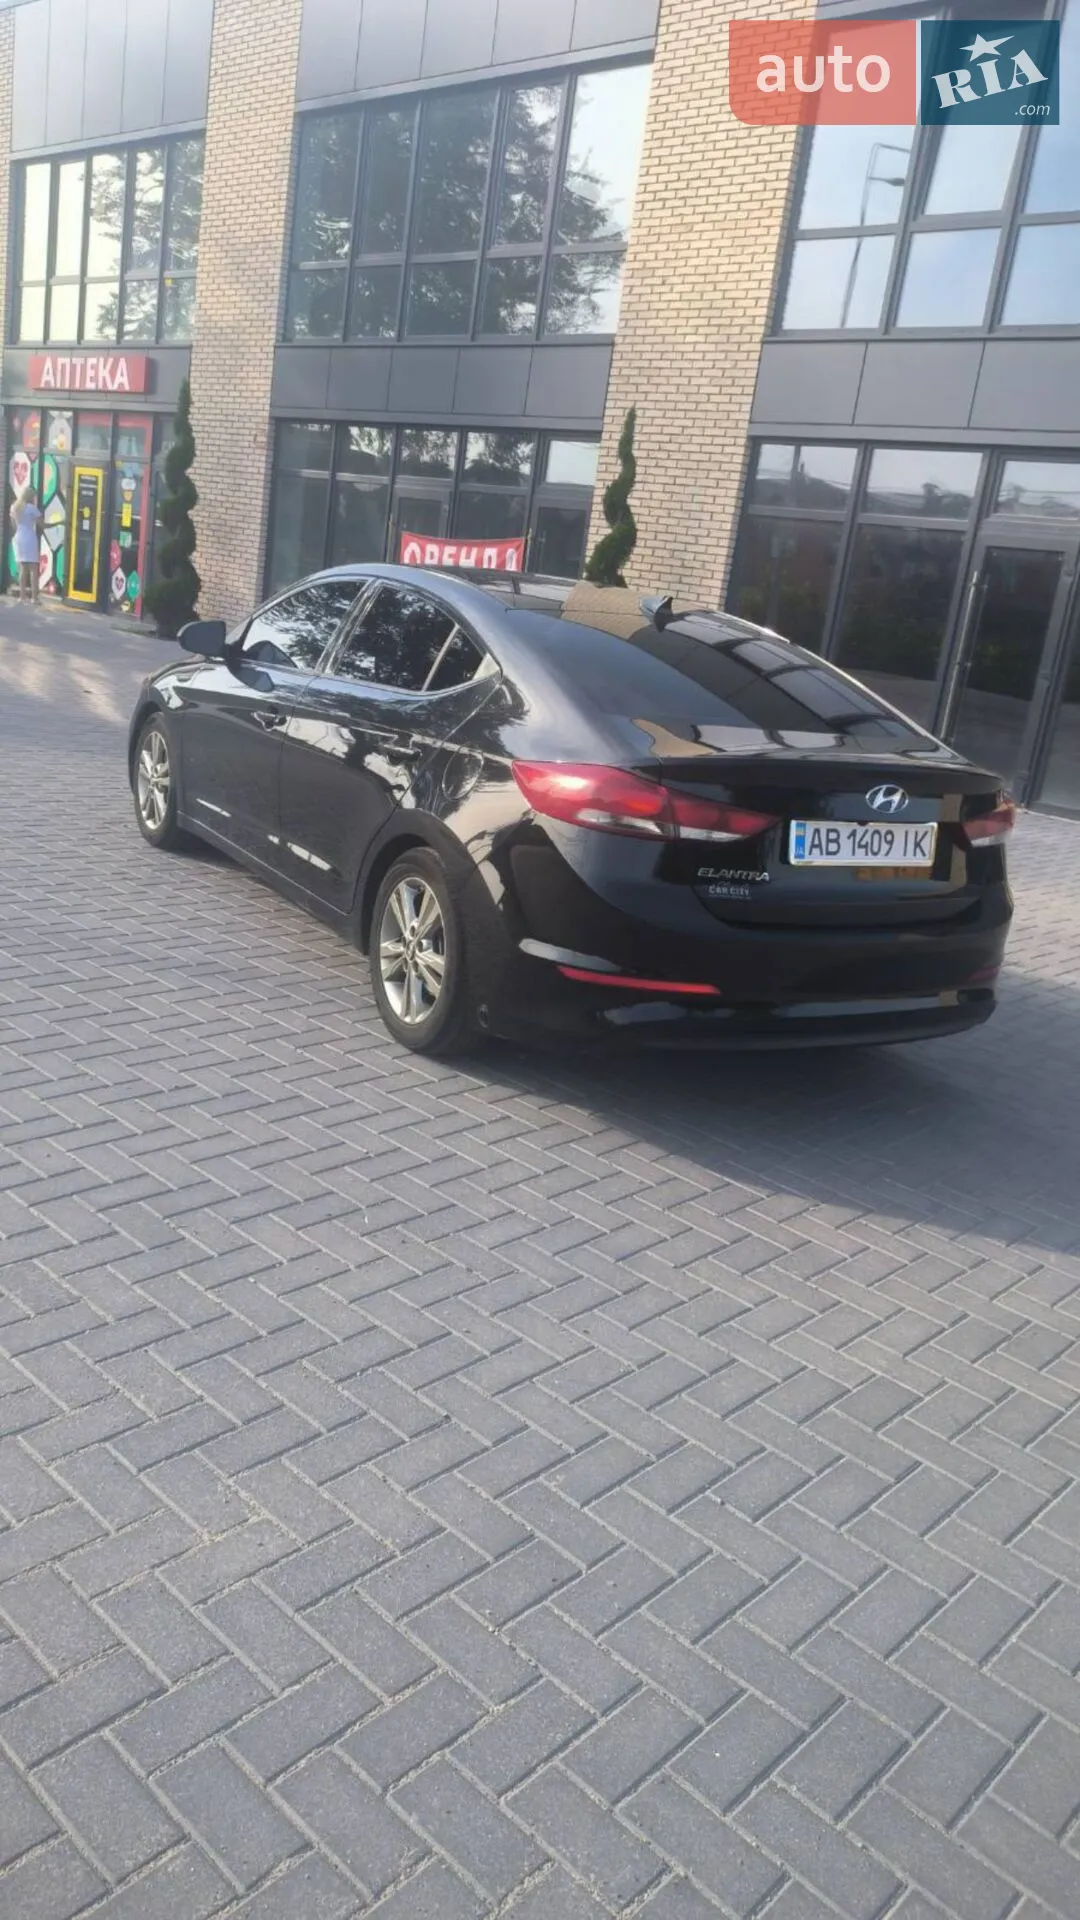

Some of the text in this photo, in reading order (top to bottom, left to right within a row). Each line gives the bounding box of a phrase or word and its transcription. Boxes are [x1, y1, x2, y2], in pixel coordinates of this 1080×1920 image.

[40, 356, 130, 390] АПТЕКА
[808, 828, 841, 856] AB
[847, 829, 895, 858] 1409
[697, 867, 770, 882] ELANTRA
